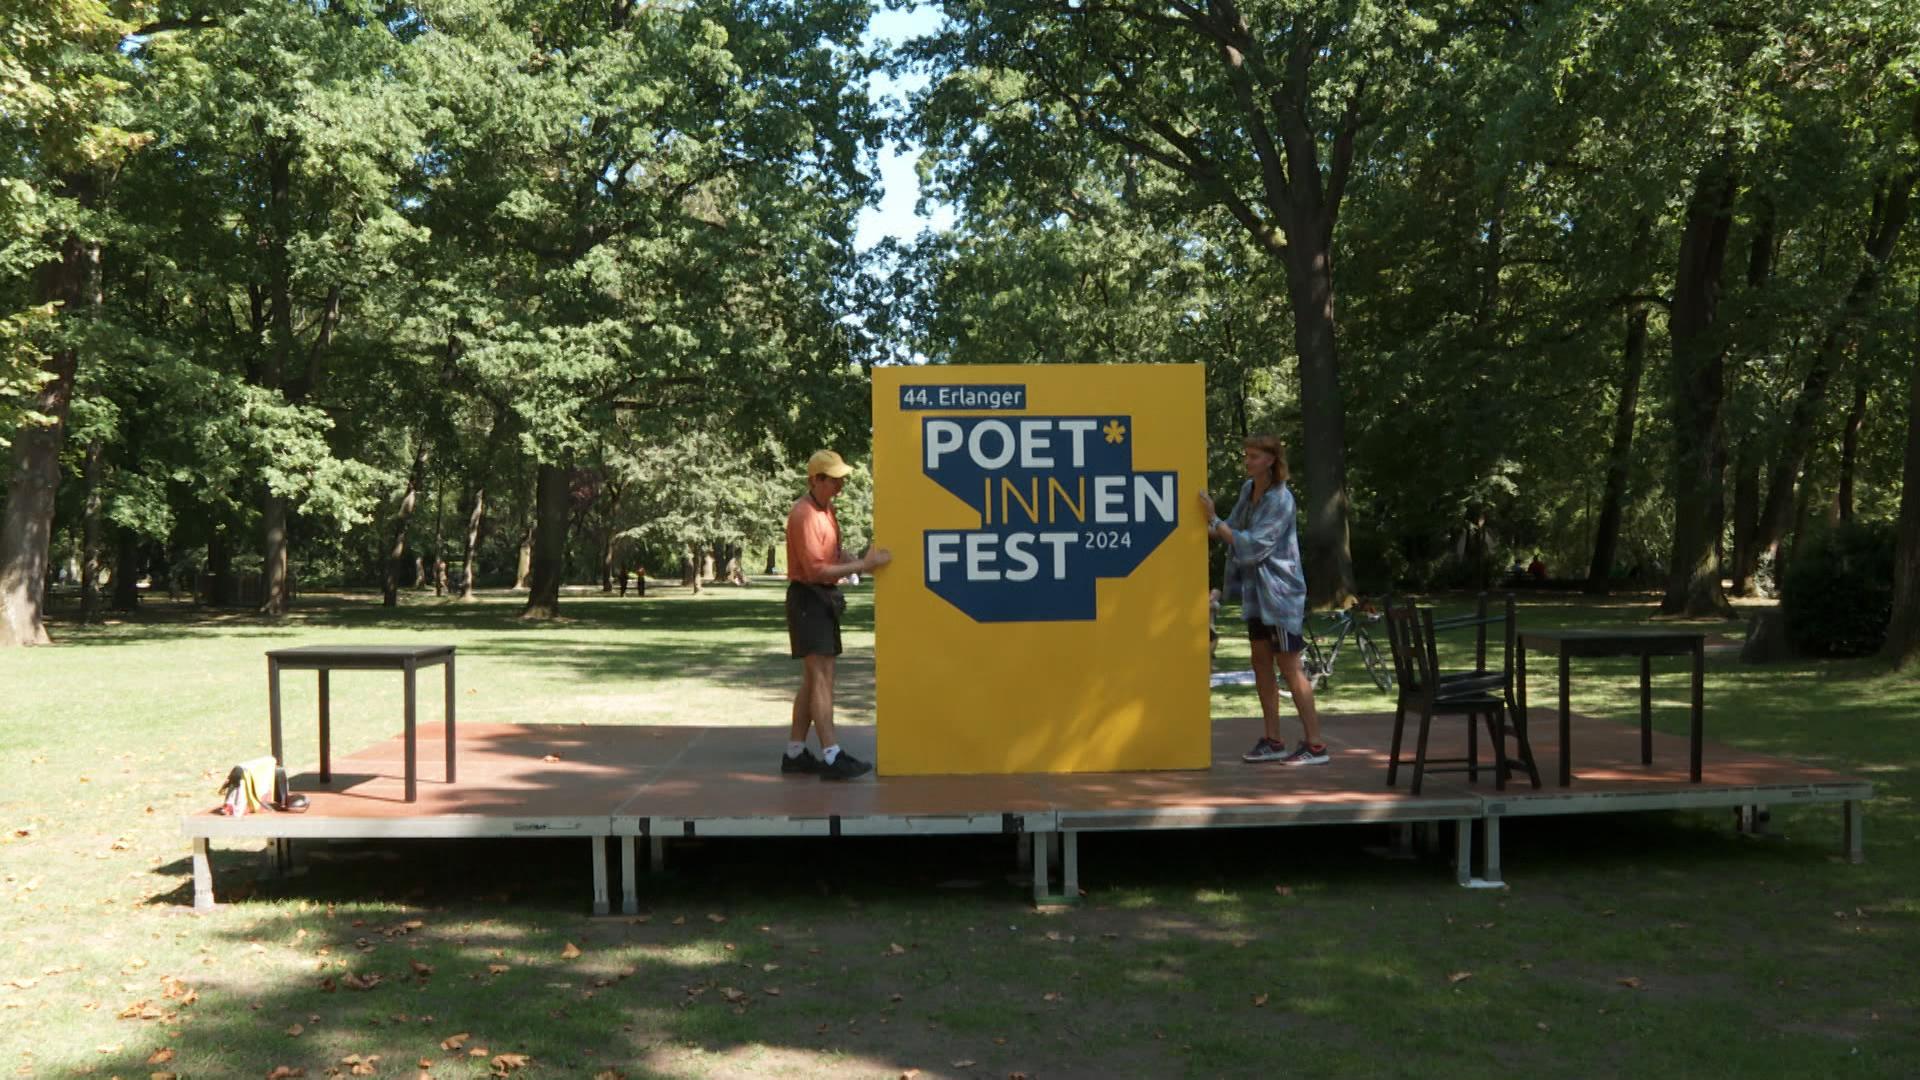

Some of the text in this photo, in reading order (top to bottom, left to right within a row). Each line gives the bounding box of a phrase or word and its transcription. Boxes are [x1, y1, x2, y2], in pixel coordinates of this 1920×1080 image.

[903, 387, 1022, 409] 44. Erlanger
[984, 475, 1175, 525] INNEN
[927, 531, 1132, 582] FEST 2024
